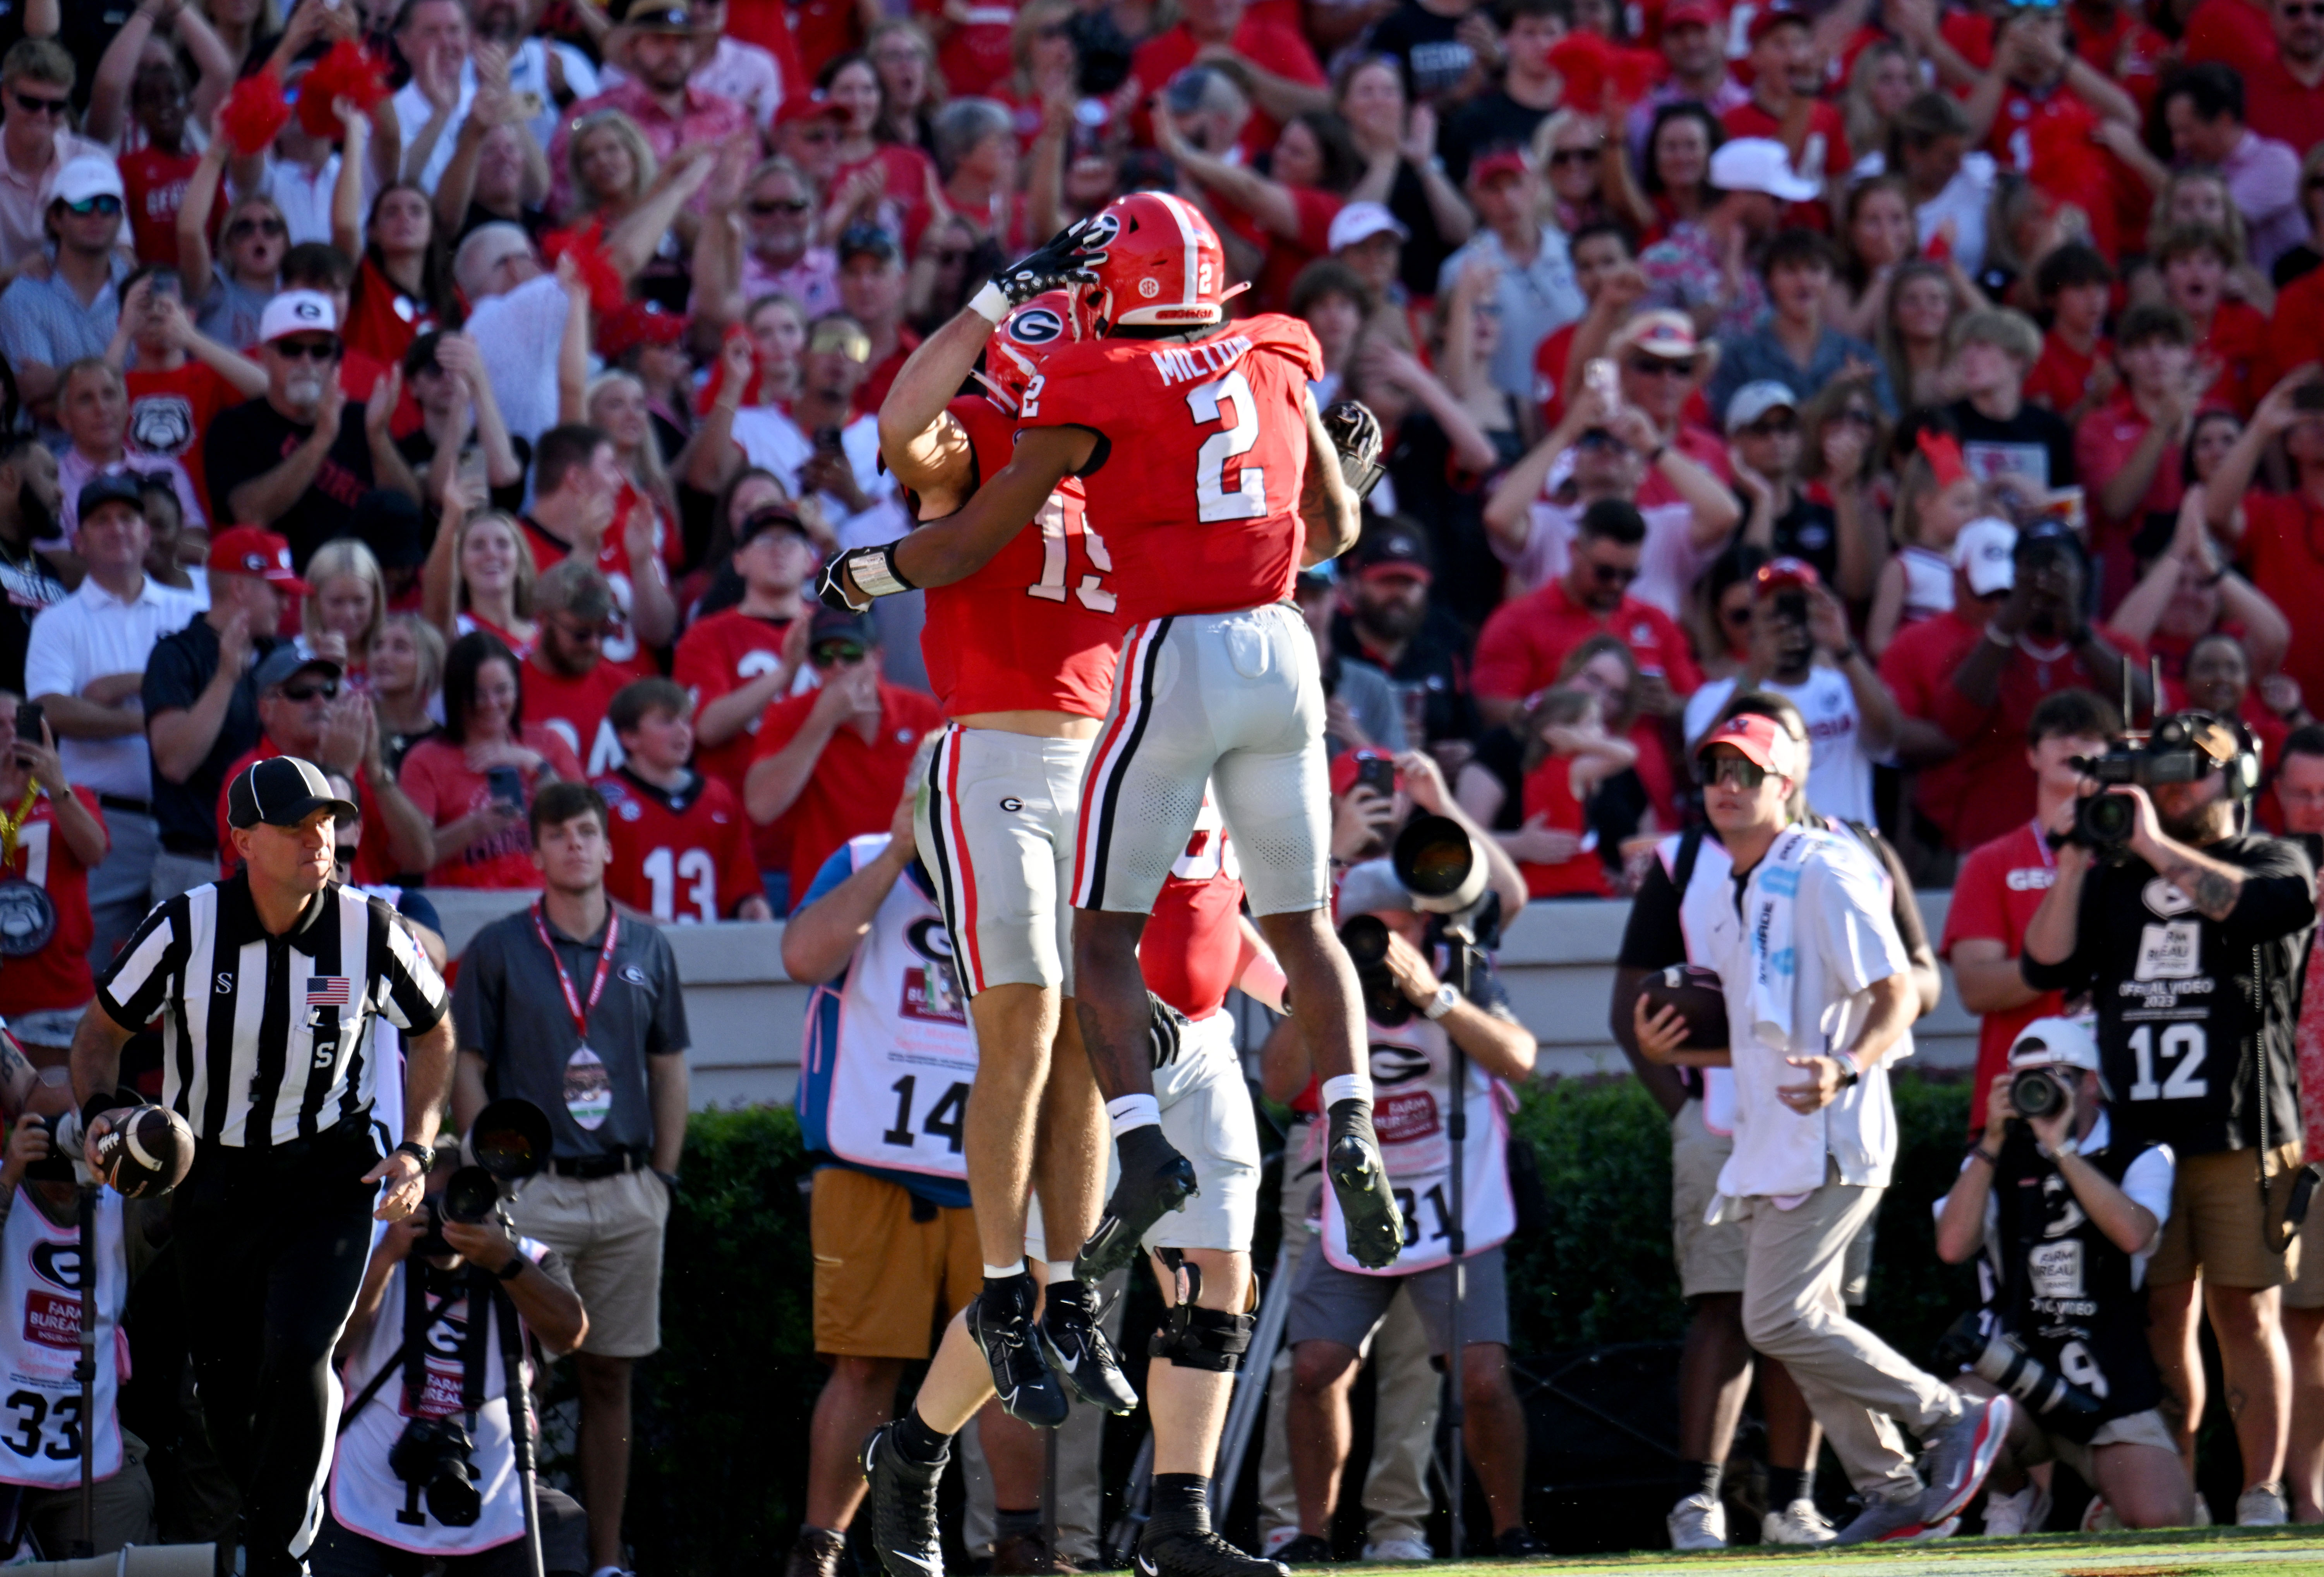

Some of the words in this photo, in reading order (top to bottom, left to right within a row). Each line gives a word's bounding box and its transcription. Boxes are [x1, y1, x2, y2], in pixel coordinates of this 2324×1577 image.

[1140, 280, 1158, 295] SEC
[1199, 263, 1212, 294] 2
[1011, 311, 1061, 341] G
[1021, 374, 1045, 418] 2
[1185, 369, 1268, 523] 2
[1001, 798, 1023, 811] G
[643, 846, 717, 924] 13
[216, 972, 232, 994] S
[314, 1042, 334, 1068] S
[2128, 1023, 2207, 1100] 12
[883, 1075, 969, 1154] 14
[1, 1389, 82, 1460] 33
